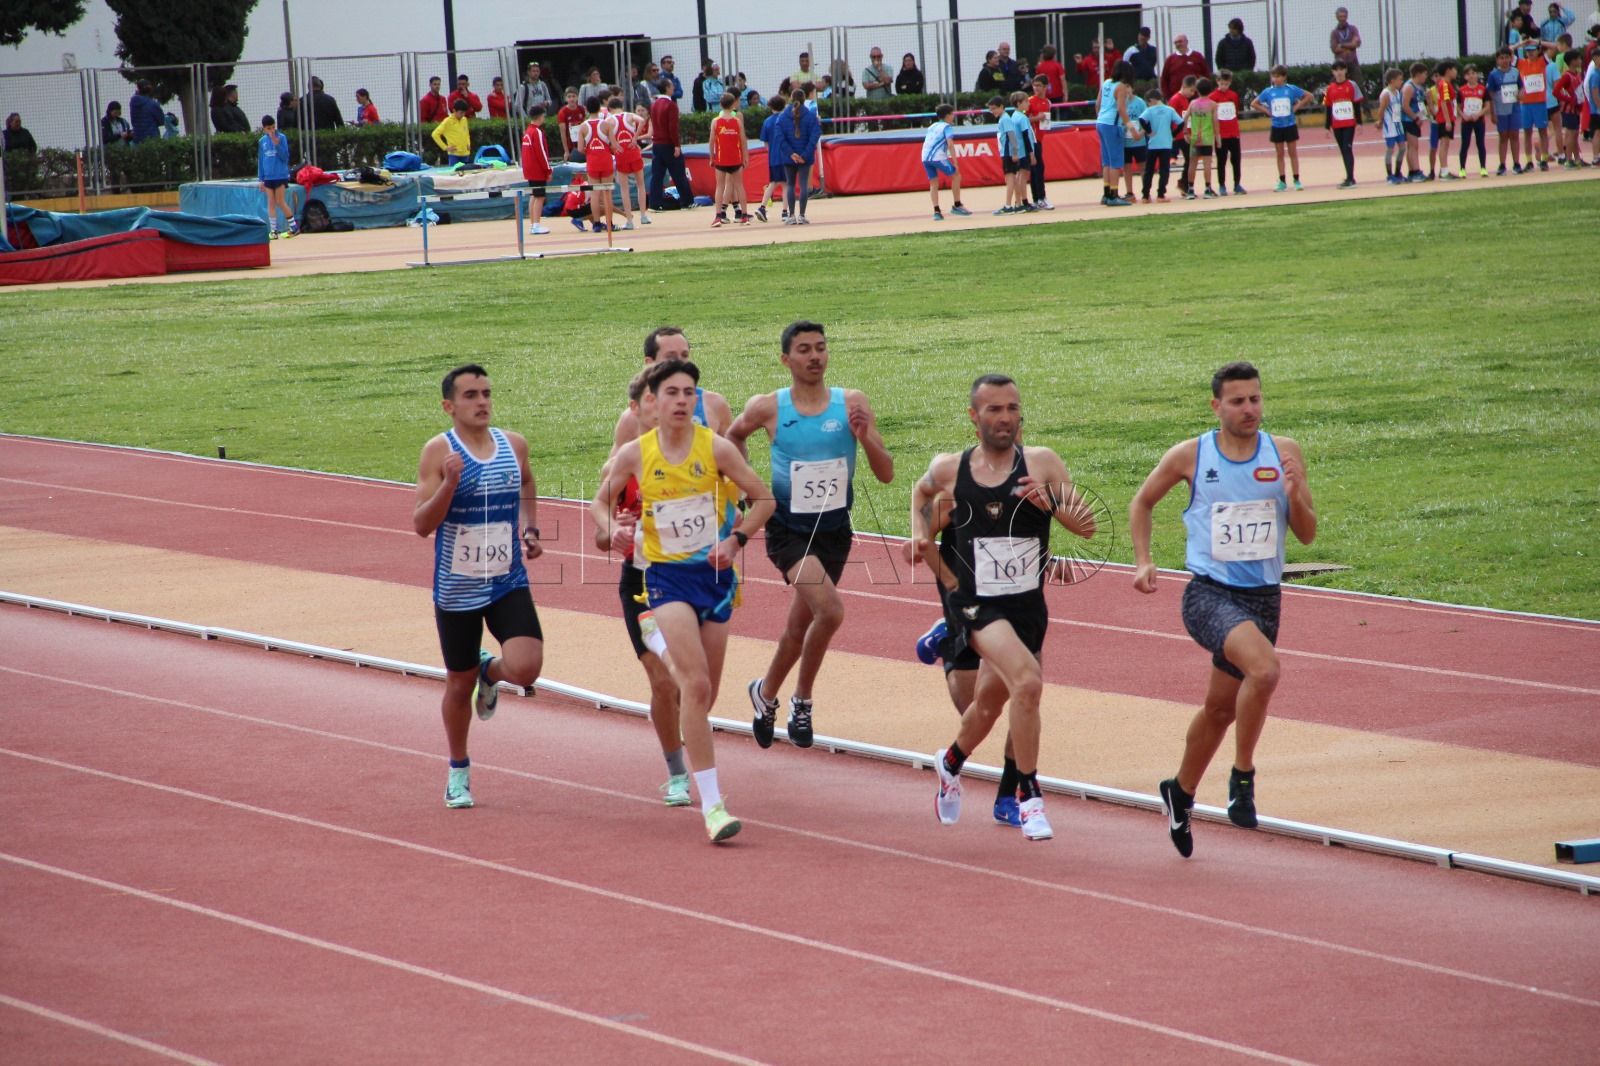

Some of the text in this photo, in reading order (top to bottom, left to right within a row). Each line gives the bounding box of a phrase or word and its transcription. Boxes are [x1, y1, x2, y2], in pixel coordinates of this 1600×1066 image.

[946, 142, 993, 158] MA
[803, 478, 839, 499] 555
[670, 514, 707, 539] 159
[1219, 521, 1272, 545] 3177
[459, 543, 509, 563] 3198
[993, 557, 1027, 581] 161
